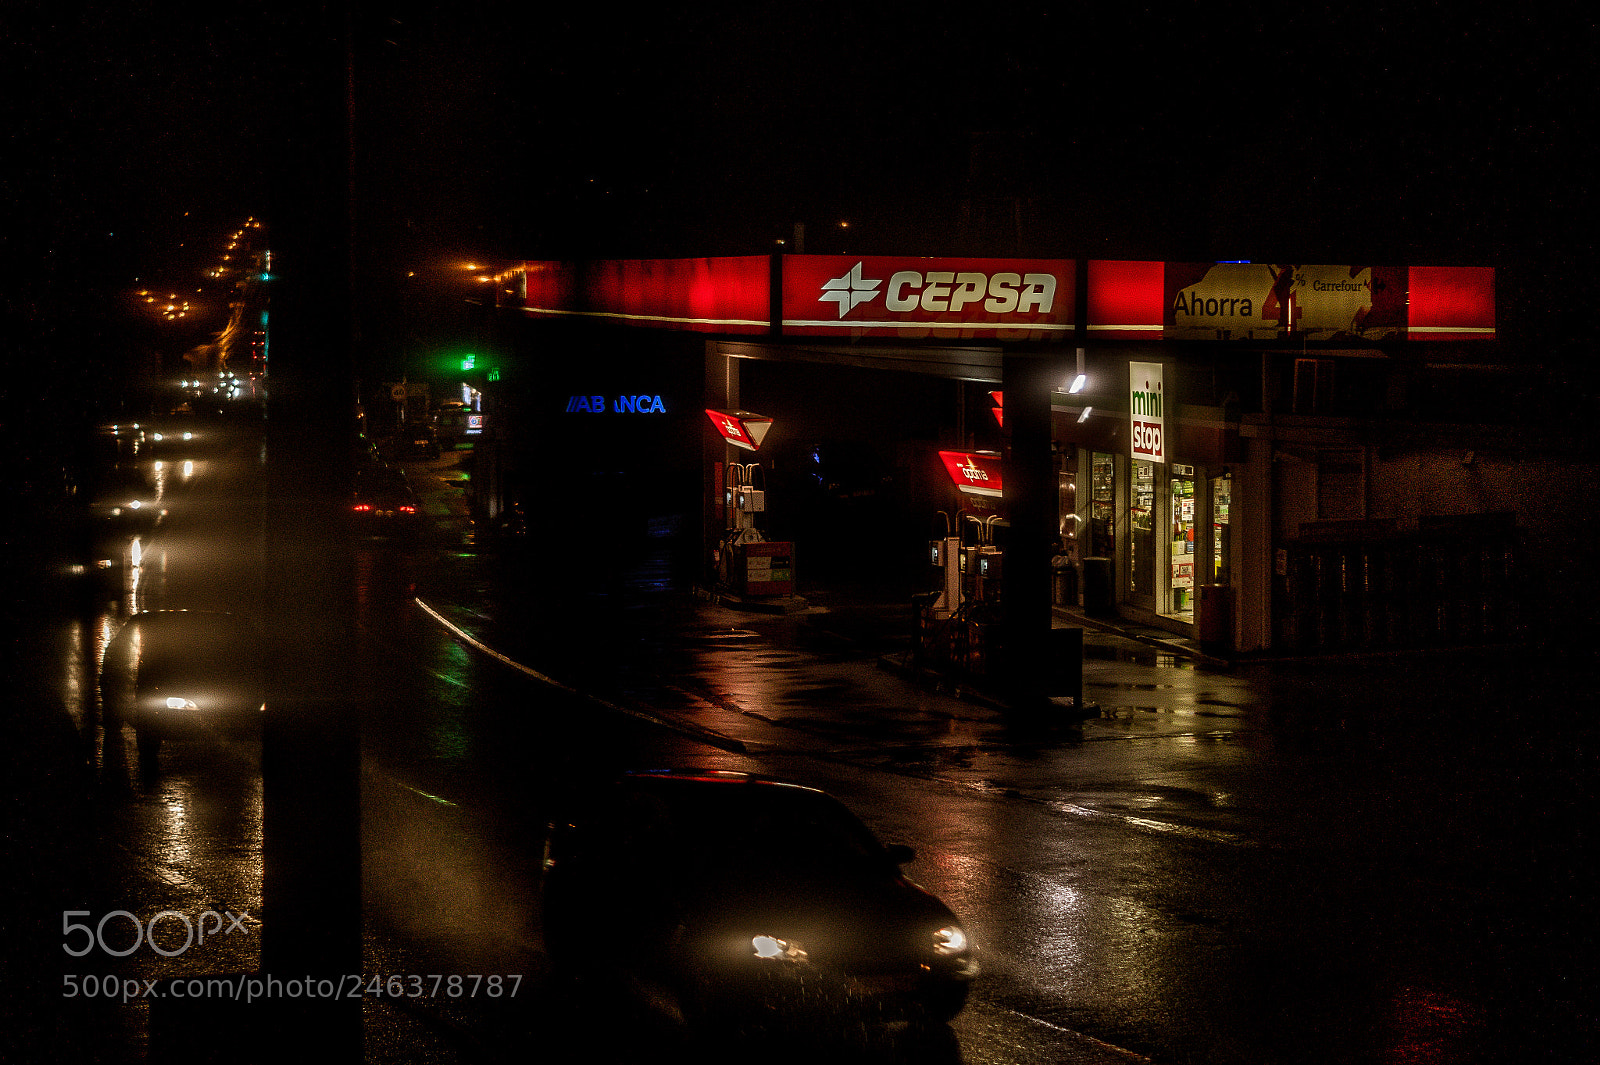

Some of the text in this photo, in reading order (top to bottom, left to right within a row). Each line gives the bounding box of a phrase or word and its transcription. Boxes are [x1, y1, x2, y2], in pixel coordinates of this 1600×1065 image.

[886, 271, 1057, 313] CEPSA
[1174, 291, 1253, 317] Ahorra
[1313, 279, 1363, 292] Carrefour
[1132, 381, 1162, 417] mini
[1134, 422, 1161, 456] stop
